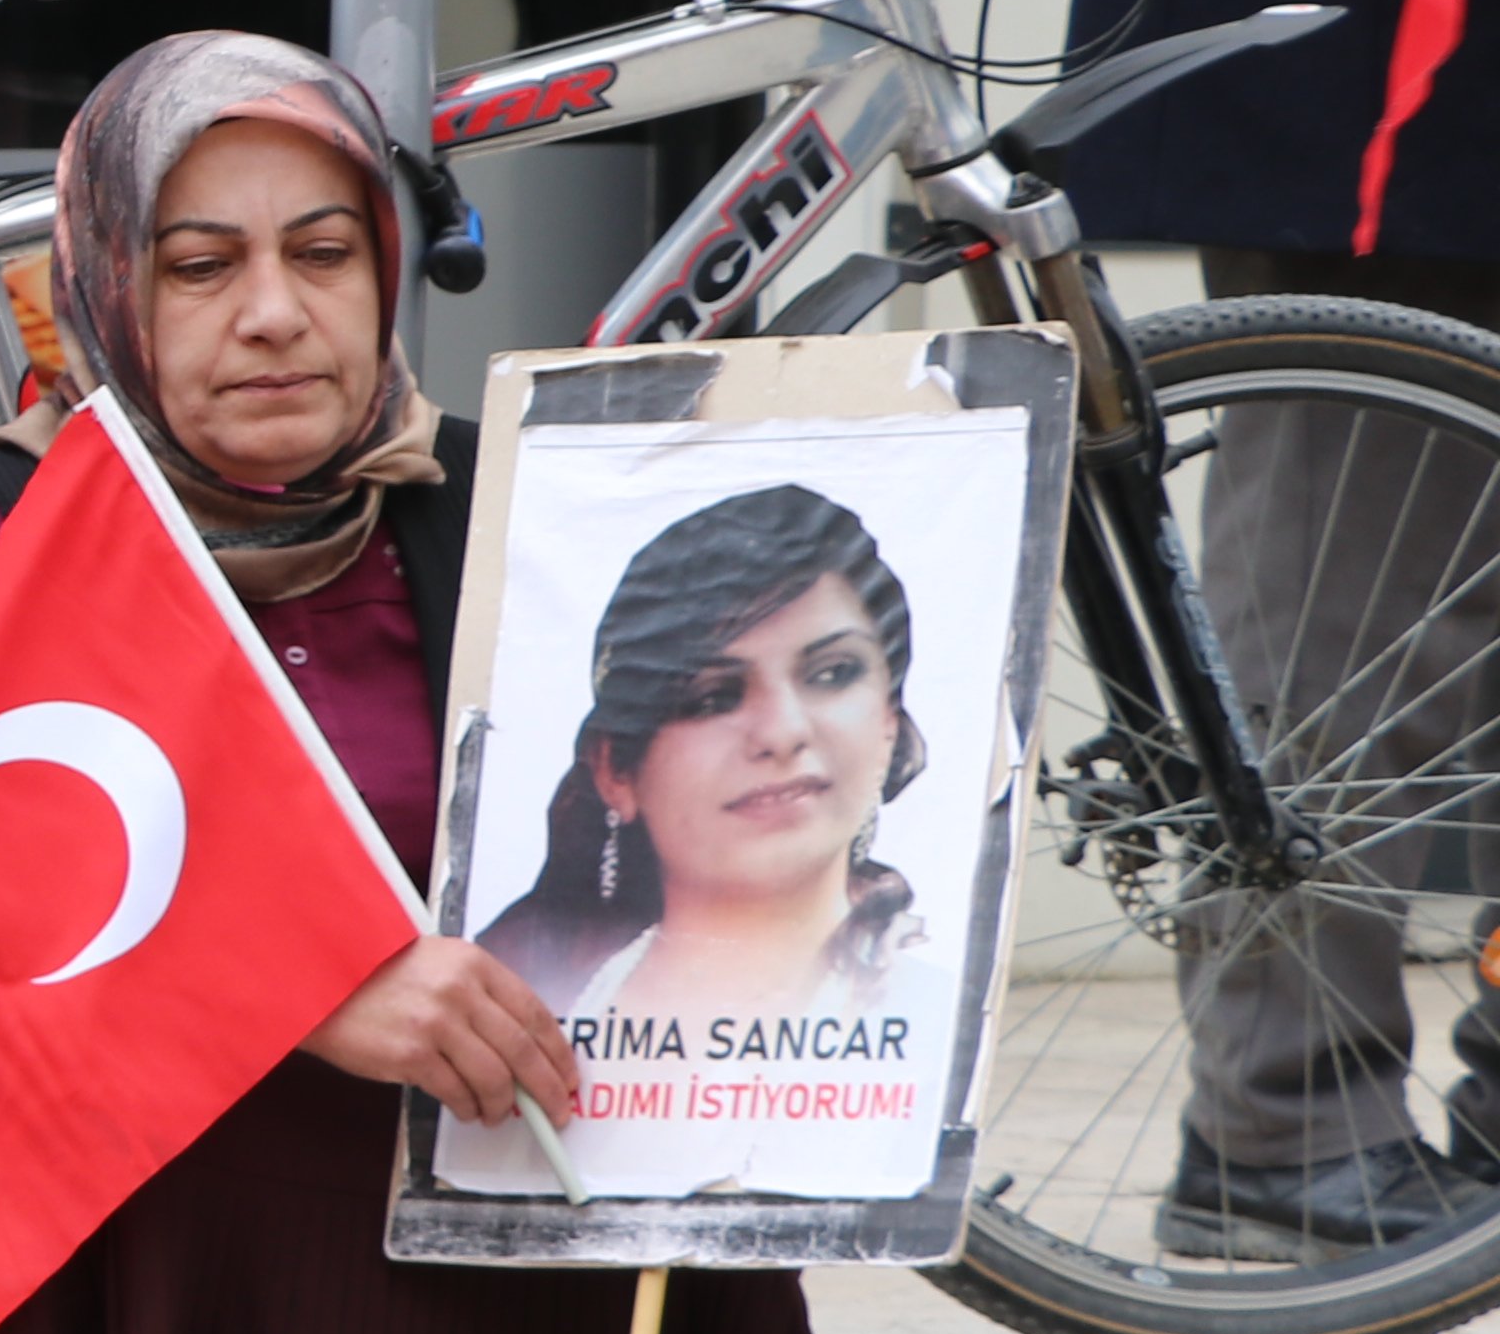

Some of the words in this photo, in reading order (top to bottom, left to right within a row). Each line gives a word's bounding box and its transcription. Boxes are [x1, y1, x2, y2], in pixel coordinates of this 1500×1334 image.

[433, 72, 614, 143] KAR
[633, 134, 833, 342] nchi
[559, 1007, 686, 1059] RİMA
[706, 1017, 909, 1059] SANCAR
[569, 1083, 674, 1120] ADIMI
[687, 1074, 916, 1120] İSTİYORUM!
